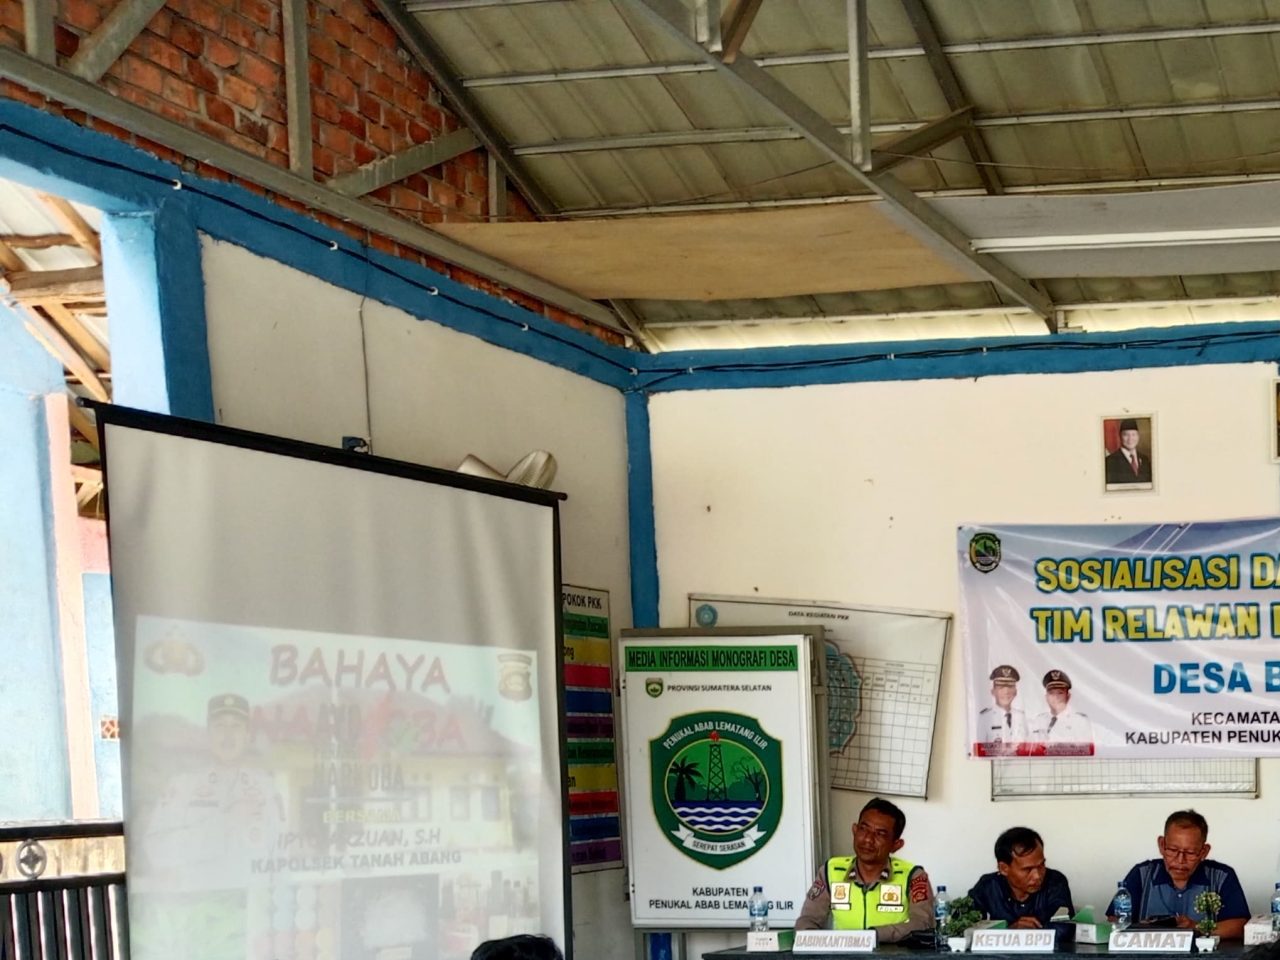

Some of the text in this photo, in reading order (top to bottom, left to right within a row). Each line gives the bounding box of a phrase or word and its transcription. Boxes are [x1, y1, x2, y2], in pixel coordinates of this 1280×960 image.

[1035, 555, 1240, 592] SOSIALISASI
[587, 596, 602, 609] PKK
[1031, 606, 1094, 643] TIM
[1102, 602, 1260, 643] RELAWAN
[629, 650, 795, 668] MEDIA INFORMASI MONOGRAFI DESA
[270, 644, 451, 693] BAHAYA
[1154, 662, 1252, 694] DESA
[663, 721, 768, 750] PENUKAL ABAB LEMATANG ILIR
[1125, 731, 1222, 744] KABUPATEN
[251, 850, 462, 874] KAPOLSEK TANAH ABANG
[692, 887, 749, 897] KABUPATEN
[649, 900, 692, 909] PENUKAL
[694, 900, 720, 909] ABAB
[723, 900, 774, 910] LEMAG
[776, 901, 794, 910] ILIR
[974, 932, 1052, 947] KETUA BPD
[1113, 932, 1191, 948] CAMAT
